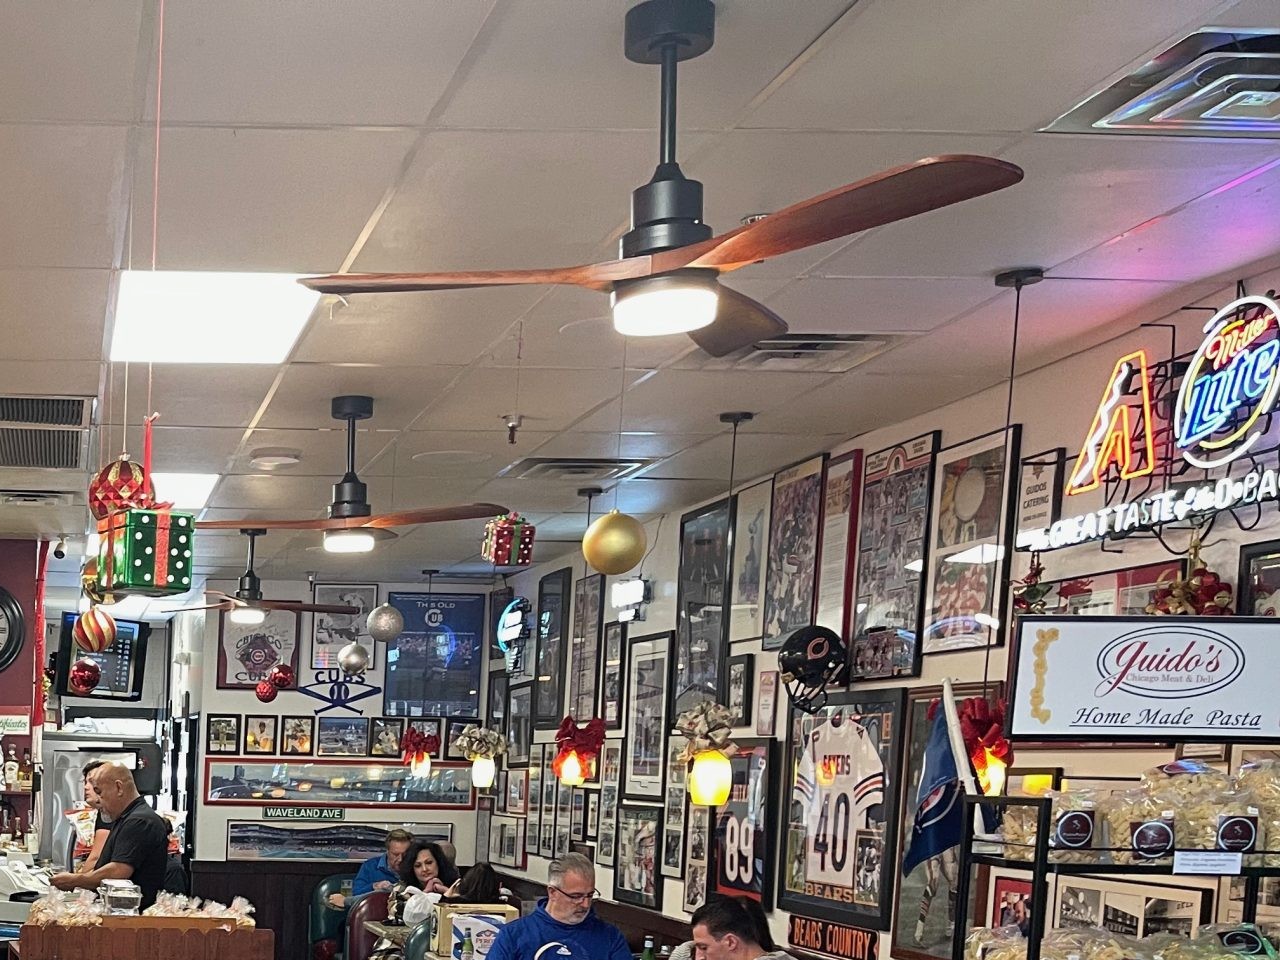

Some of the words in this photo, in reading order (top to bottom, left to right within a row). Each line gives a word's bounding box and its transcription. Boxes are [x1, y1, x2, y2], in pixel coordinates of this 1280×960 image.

[1205, 313, 1276, 371] Miller
[1177, 339, 1280, 449] Lite
[1026, 481, 1047, 495] GUIDOS
[1023, 494, 1049, 509] CATERING
[1049, 507, 1113, 548] GREAT
[1112, 489, 1174, 533] TASTE
[437, 602, 456, 610] OLD
[235, 671, 270, 681] CUB
[1095, 639, 1223, 698] Guido's
[1125, 673, 1160, 683] Chicago
[1161, 673, 1183, 683] Meat
[1185, 673, 1193, 683] &
[1195, 673, 1214, 683] Deli
[1072, 707, 1131, 725] Home
[1135, 707, 1194, 726] Made
[1206, 709, 1262, 727] Pasta
[266, 808, 321, 818] WAVELAND
[321, 809, 342, 818] AVE
[814, 792, 850, 873] 40
[724, 816, 755, 886] 89
[805, 882, 854, 903] BEARS
[793, 917, 822, 949] BEARS
